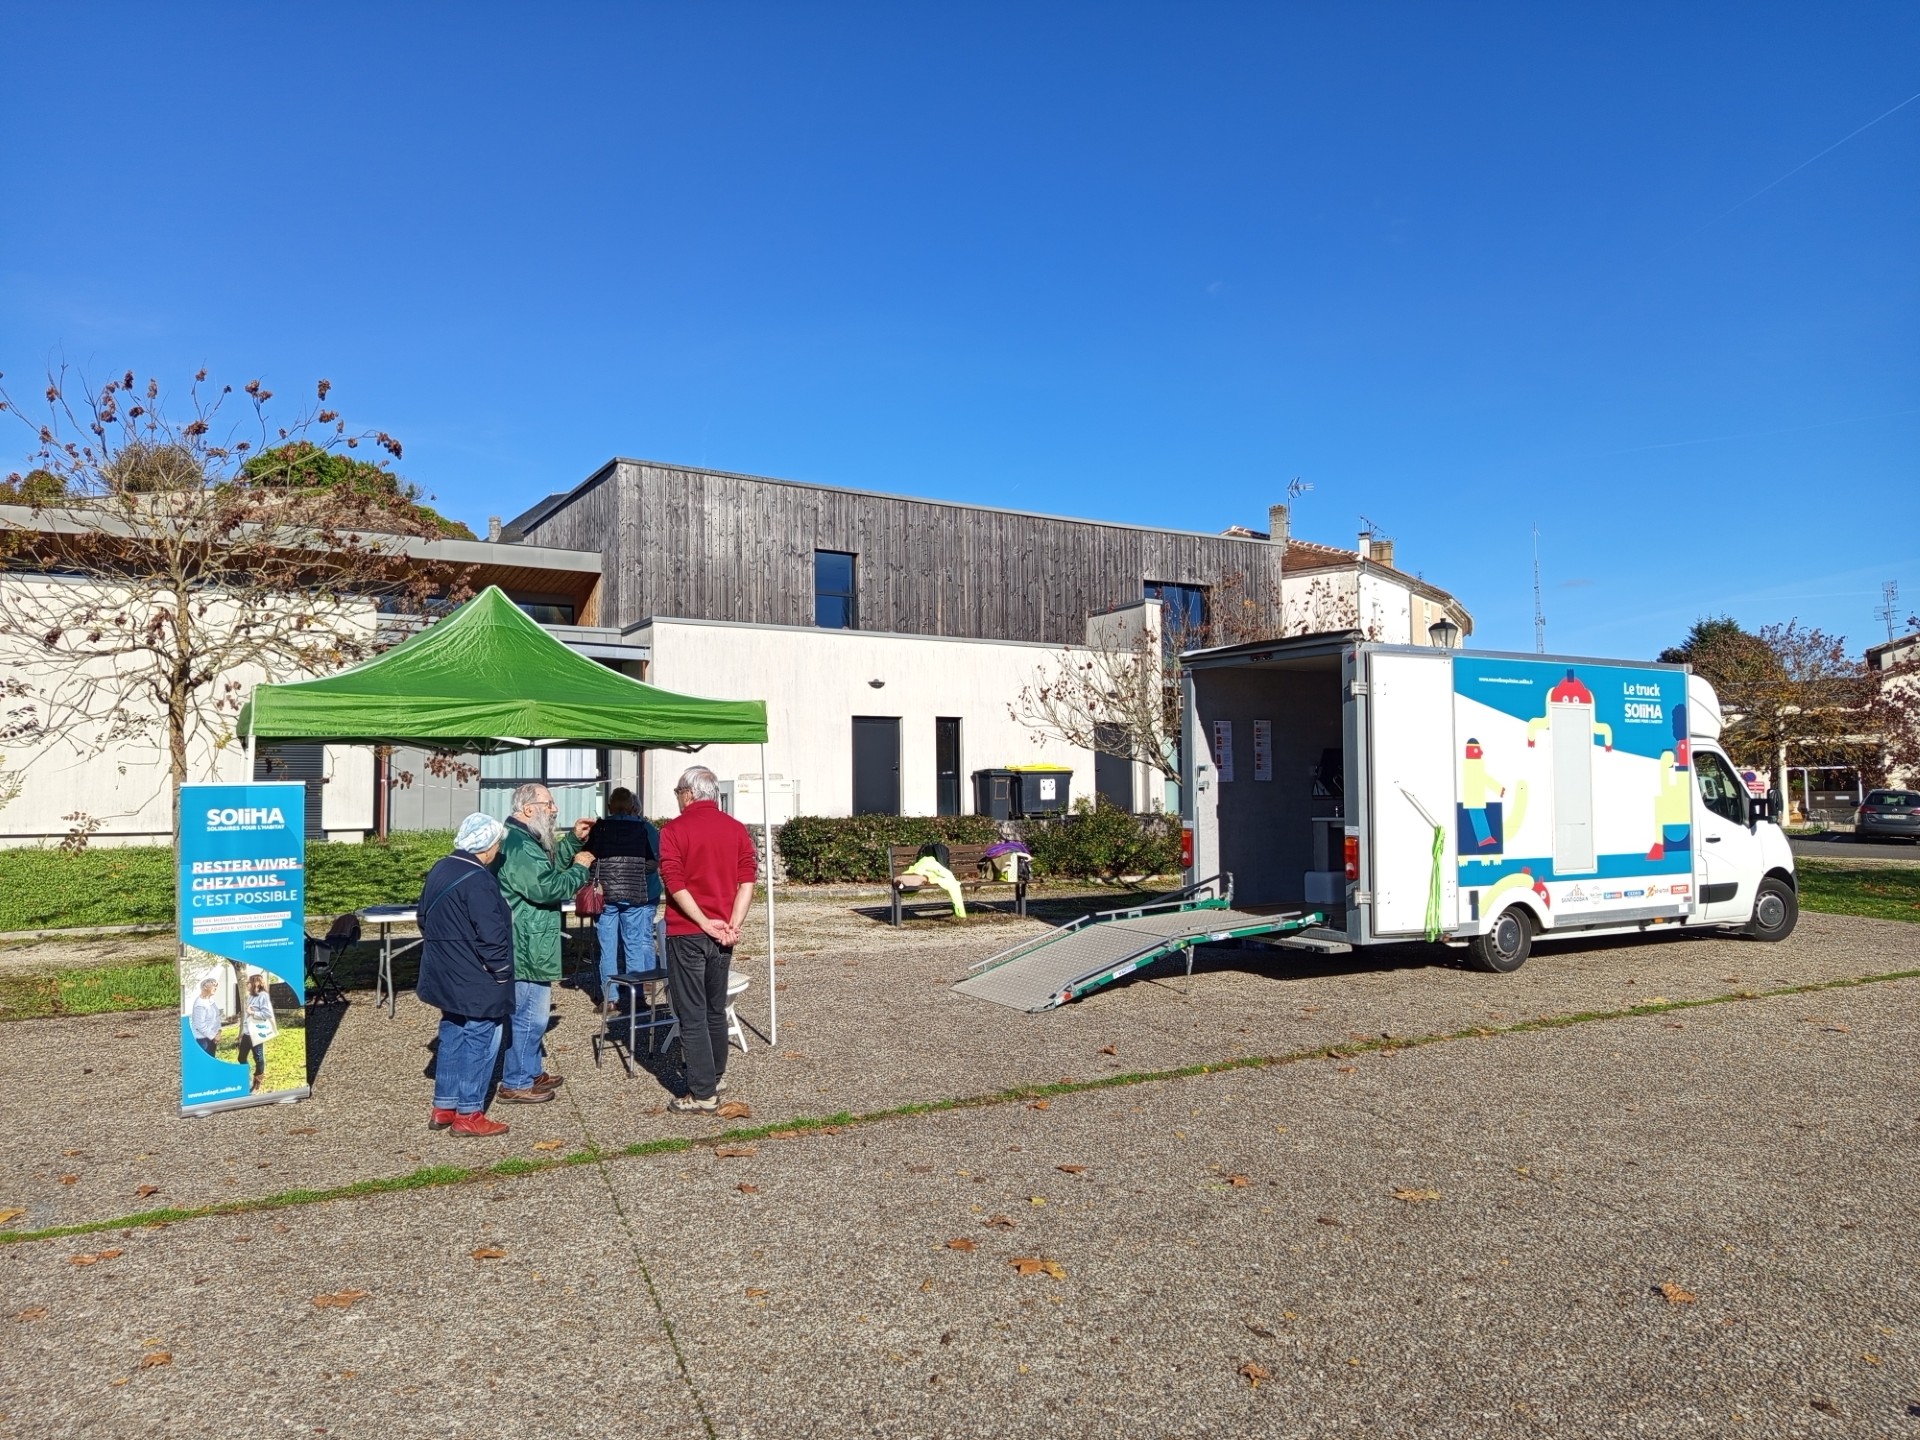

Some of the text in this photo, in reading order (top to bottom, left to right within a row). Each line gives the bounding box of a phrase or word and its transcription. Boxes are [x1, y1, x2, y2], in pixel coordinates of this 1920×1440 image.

[1624, 682, 1660, 696] Le truck
[192, 858, 297, 873] RESTER VIVRE
[192, 874, 278, 890] CHEZ VOUS
[235, 889, 298, 904] POSSIBLE
